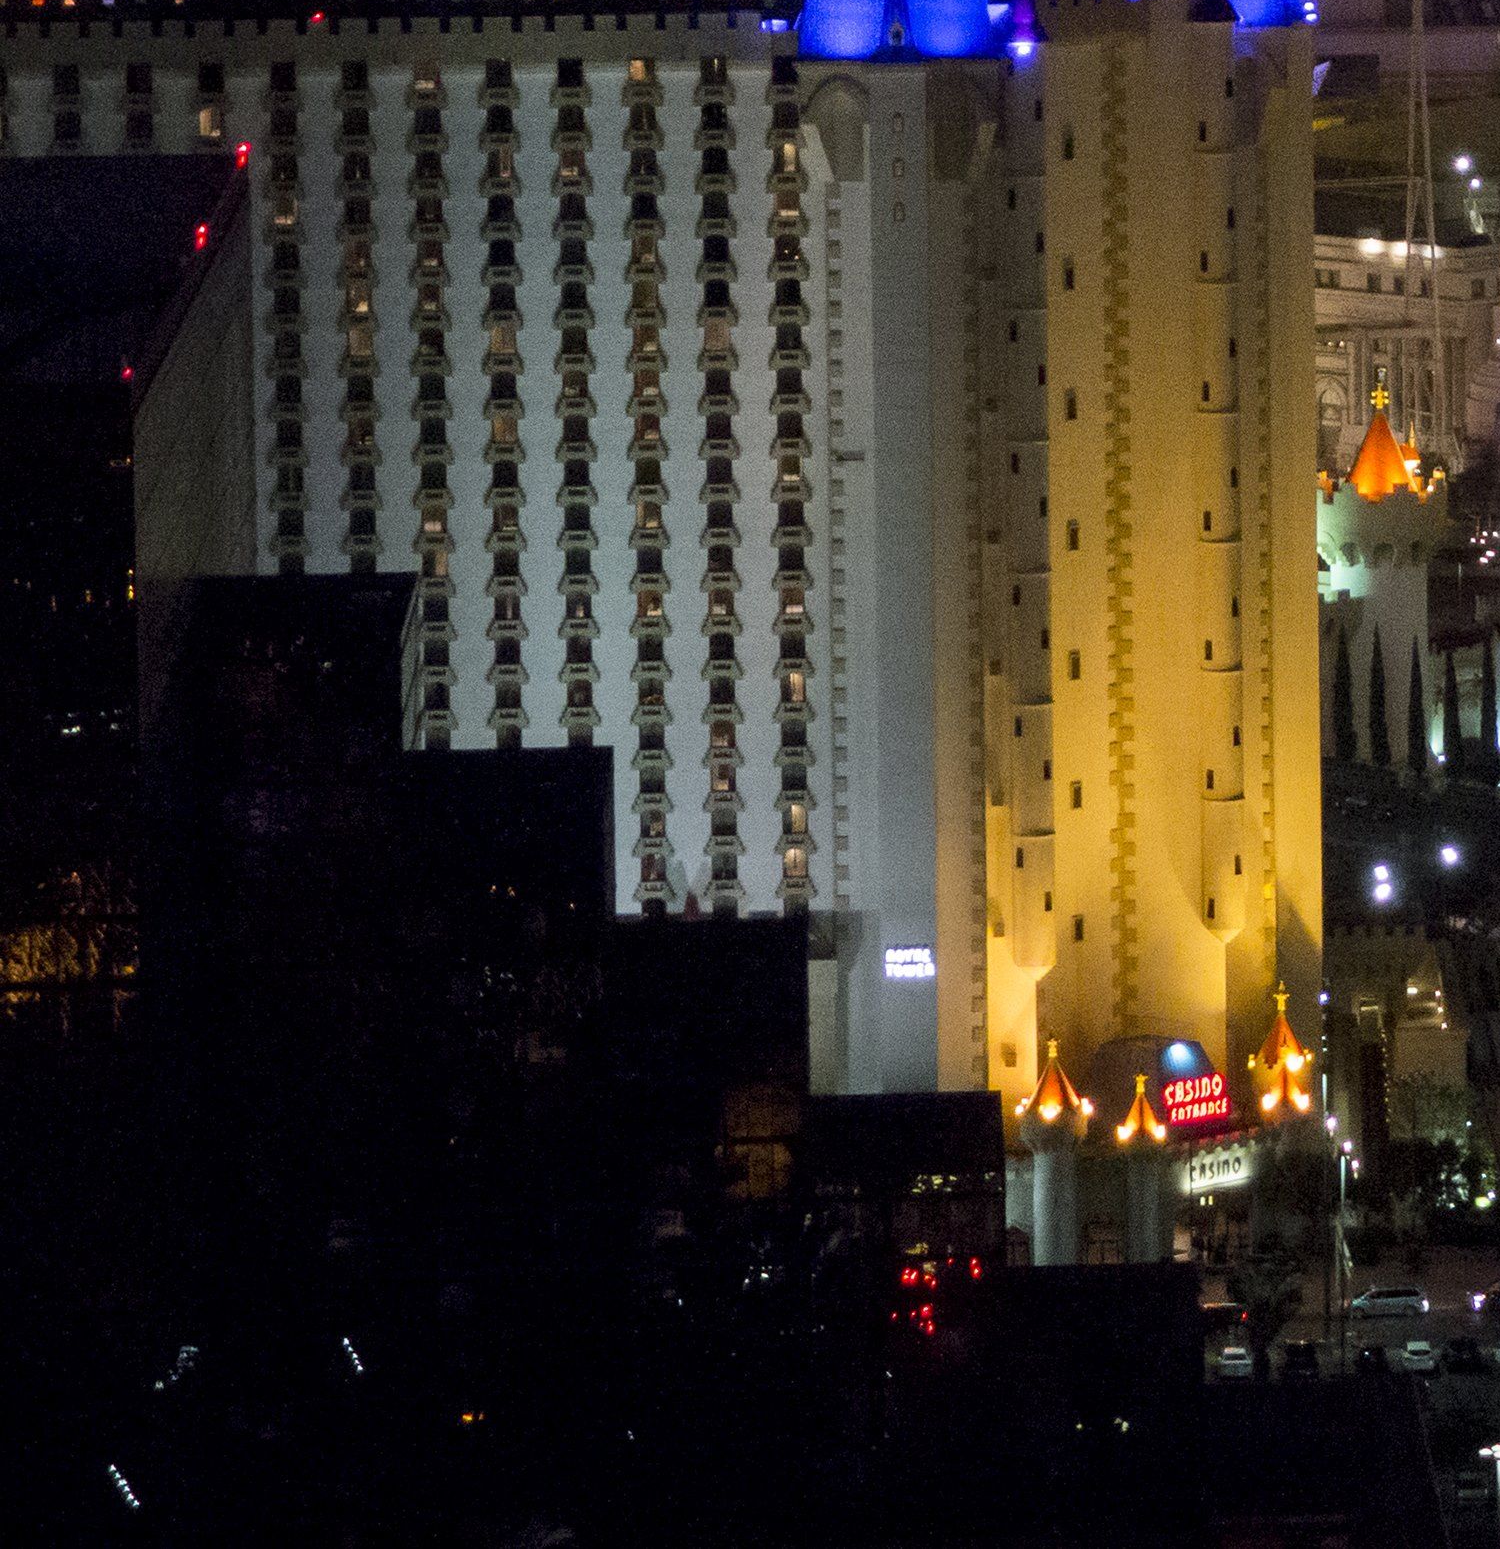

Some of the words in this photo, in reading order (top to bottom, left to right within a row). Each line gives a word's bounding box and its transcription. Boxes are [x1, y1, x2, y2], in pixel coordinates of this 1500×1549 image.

[1163, 1073, 1224, 1107] CASINO
[1169, 1097, 1228, 1124] ENTRANCE
[1189, 1155, 1244, 1184] CASINO
